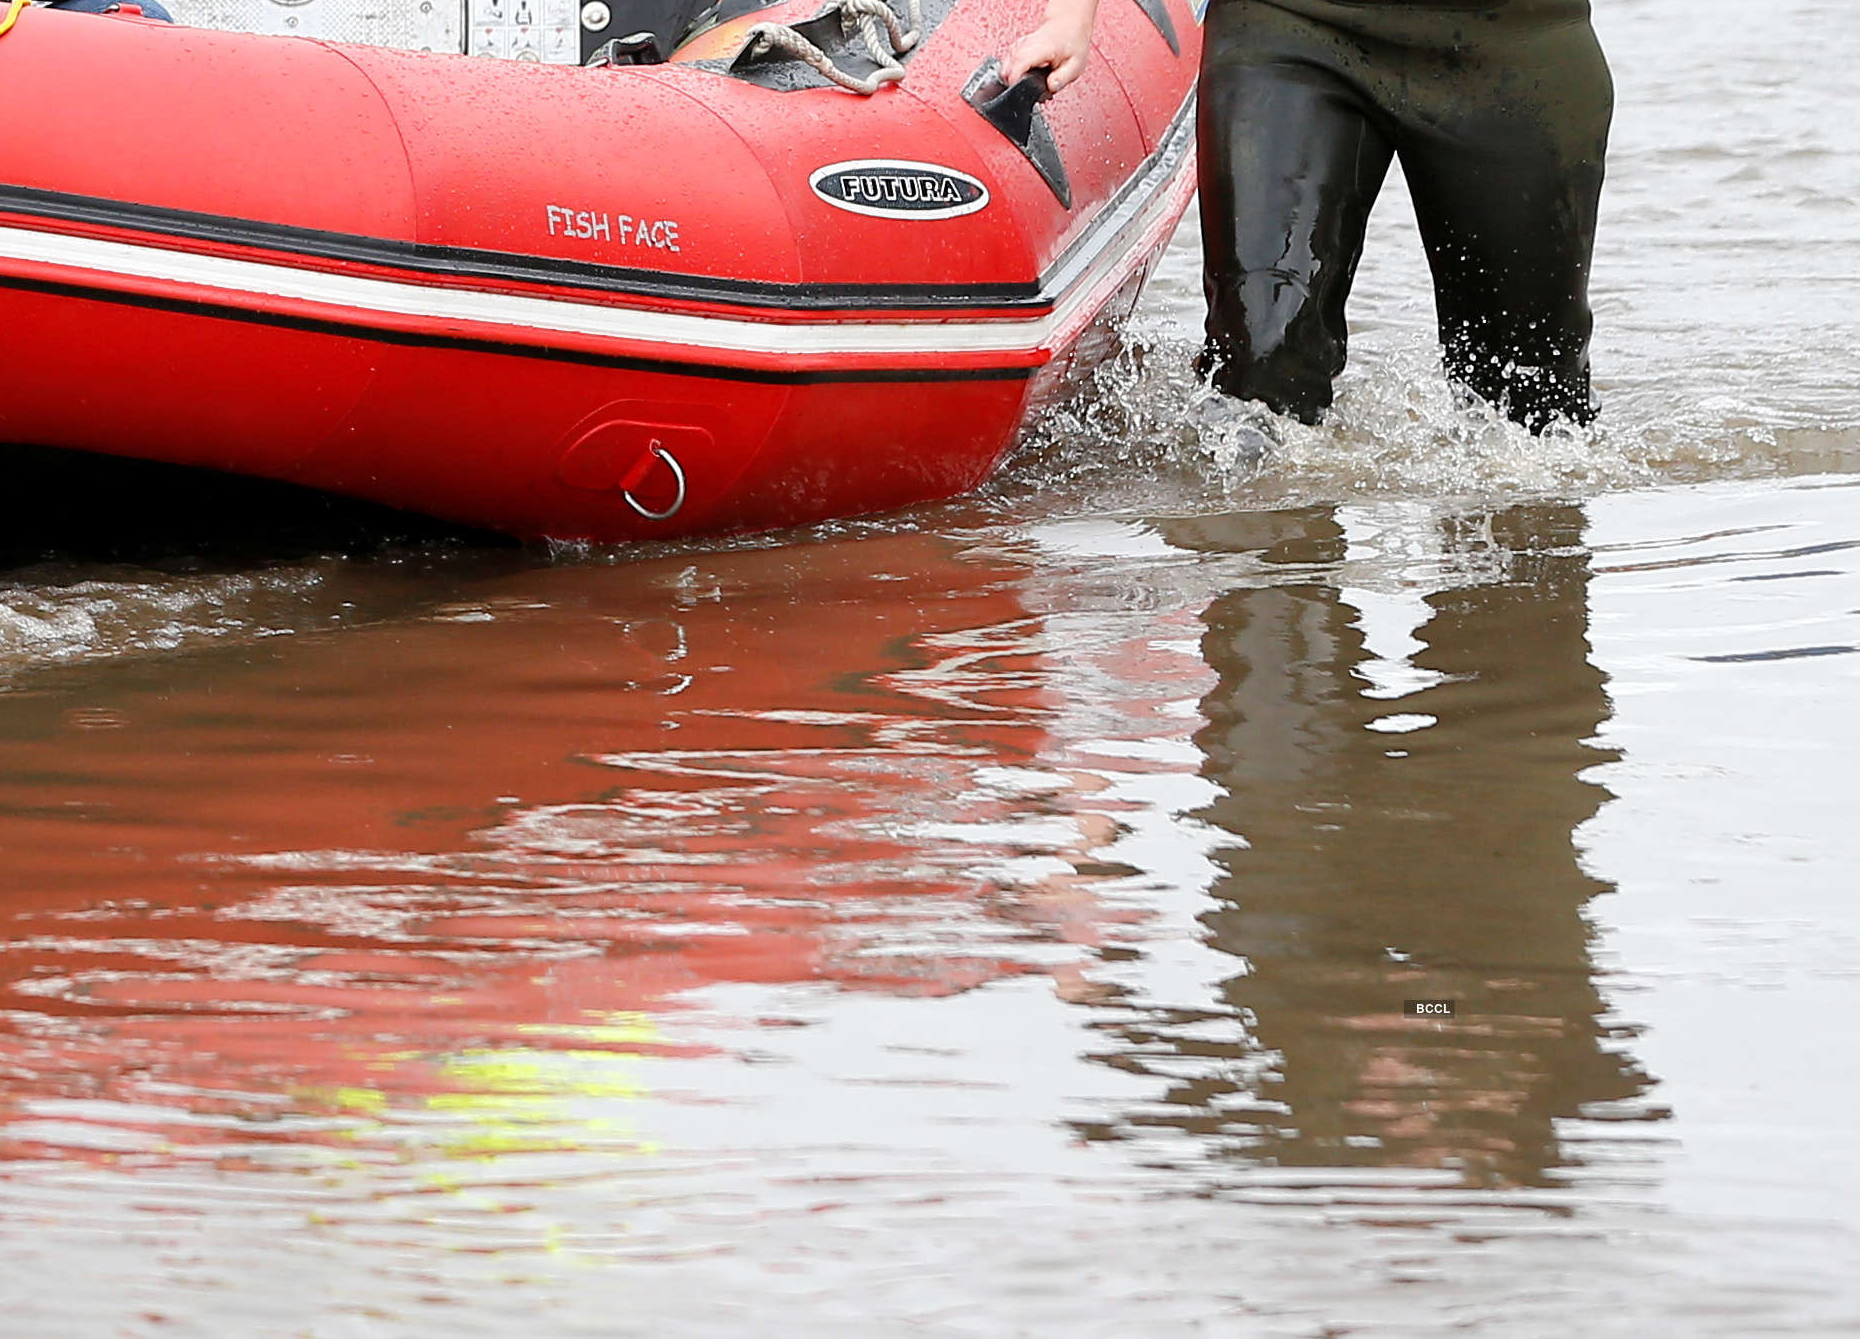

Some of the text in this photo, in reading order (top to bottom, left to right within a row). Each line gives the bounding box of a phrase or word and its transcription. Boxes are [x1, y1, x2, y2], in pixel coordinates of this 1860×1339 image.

[840, 175, 962, 202] FUTURA
[546, 205, 681, 252] FISH FACE
